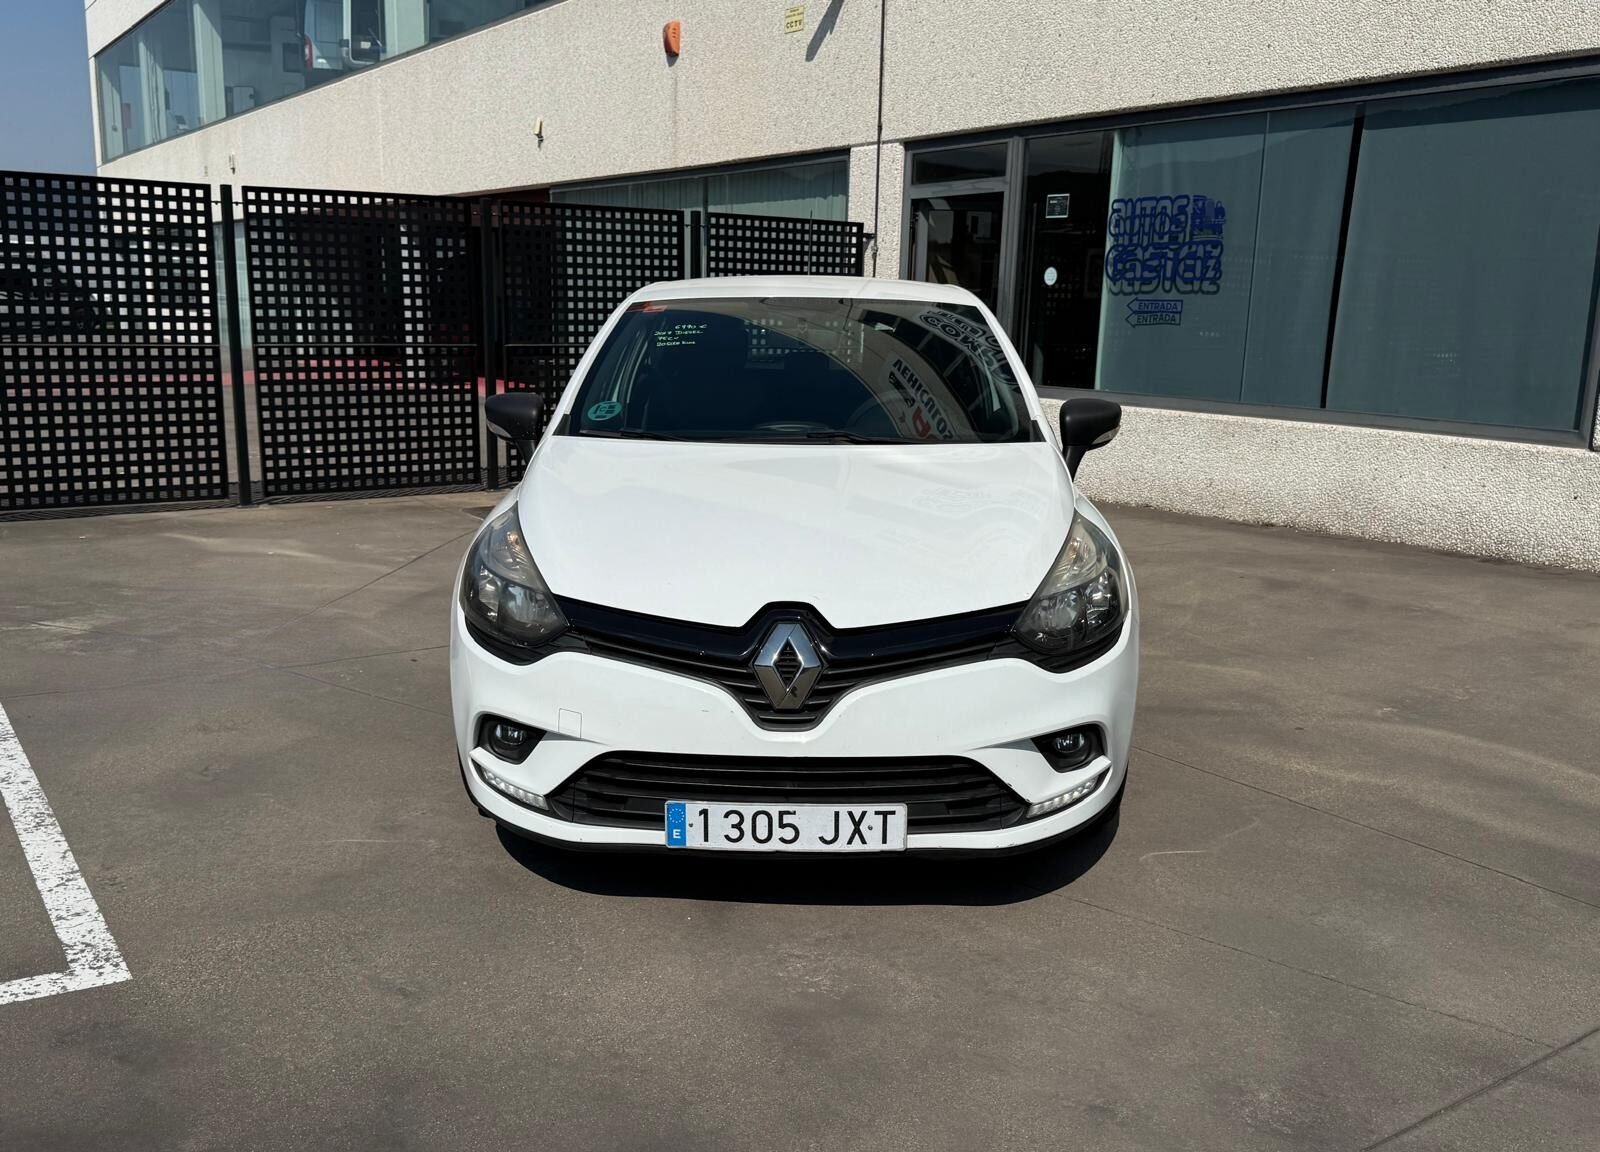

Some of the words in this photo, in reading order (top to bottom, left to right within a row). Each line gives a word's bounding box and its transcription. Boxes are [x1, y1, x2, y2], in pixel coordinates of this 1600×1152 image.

[1138, 302, 1178, 311] ENTRADA
[698, 808, 800, 845] 1305
[818, 810, 896, 846] JXT
